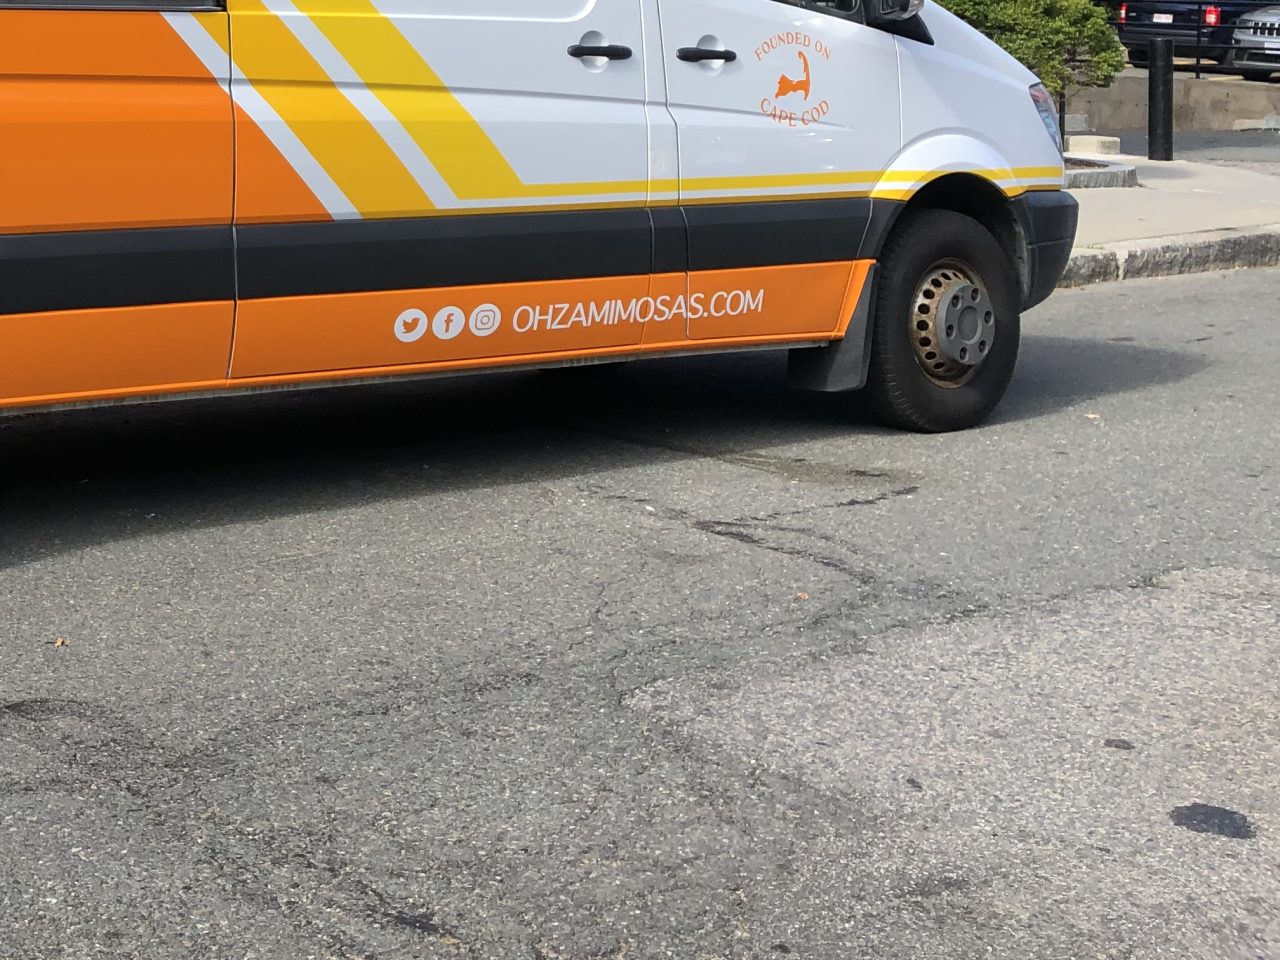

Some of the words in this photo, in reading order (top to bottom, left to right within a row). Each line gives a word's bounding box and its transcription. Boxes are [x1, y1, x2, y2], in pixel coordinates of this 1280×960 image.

[755, 32, 811, 61] FOUNDED
[815, 41, 831, 60] ON
[760, 98, 796, 127] CAPE
[801, 99, 829, 126] COD
[512, 288, 765, 334] OHZAMIMOSAS.COM
